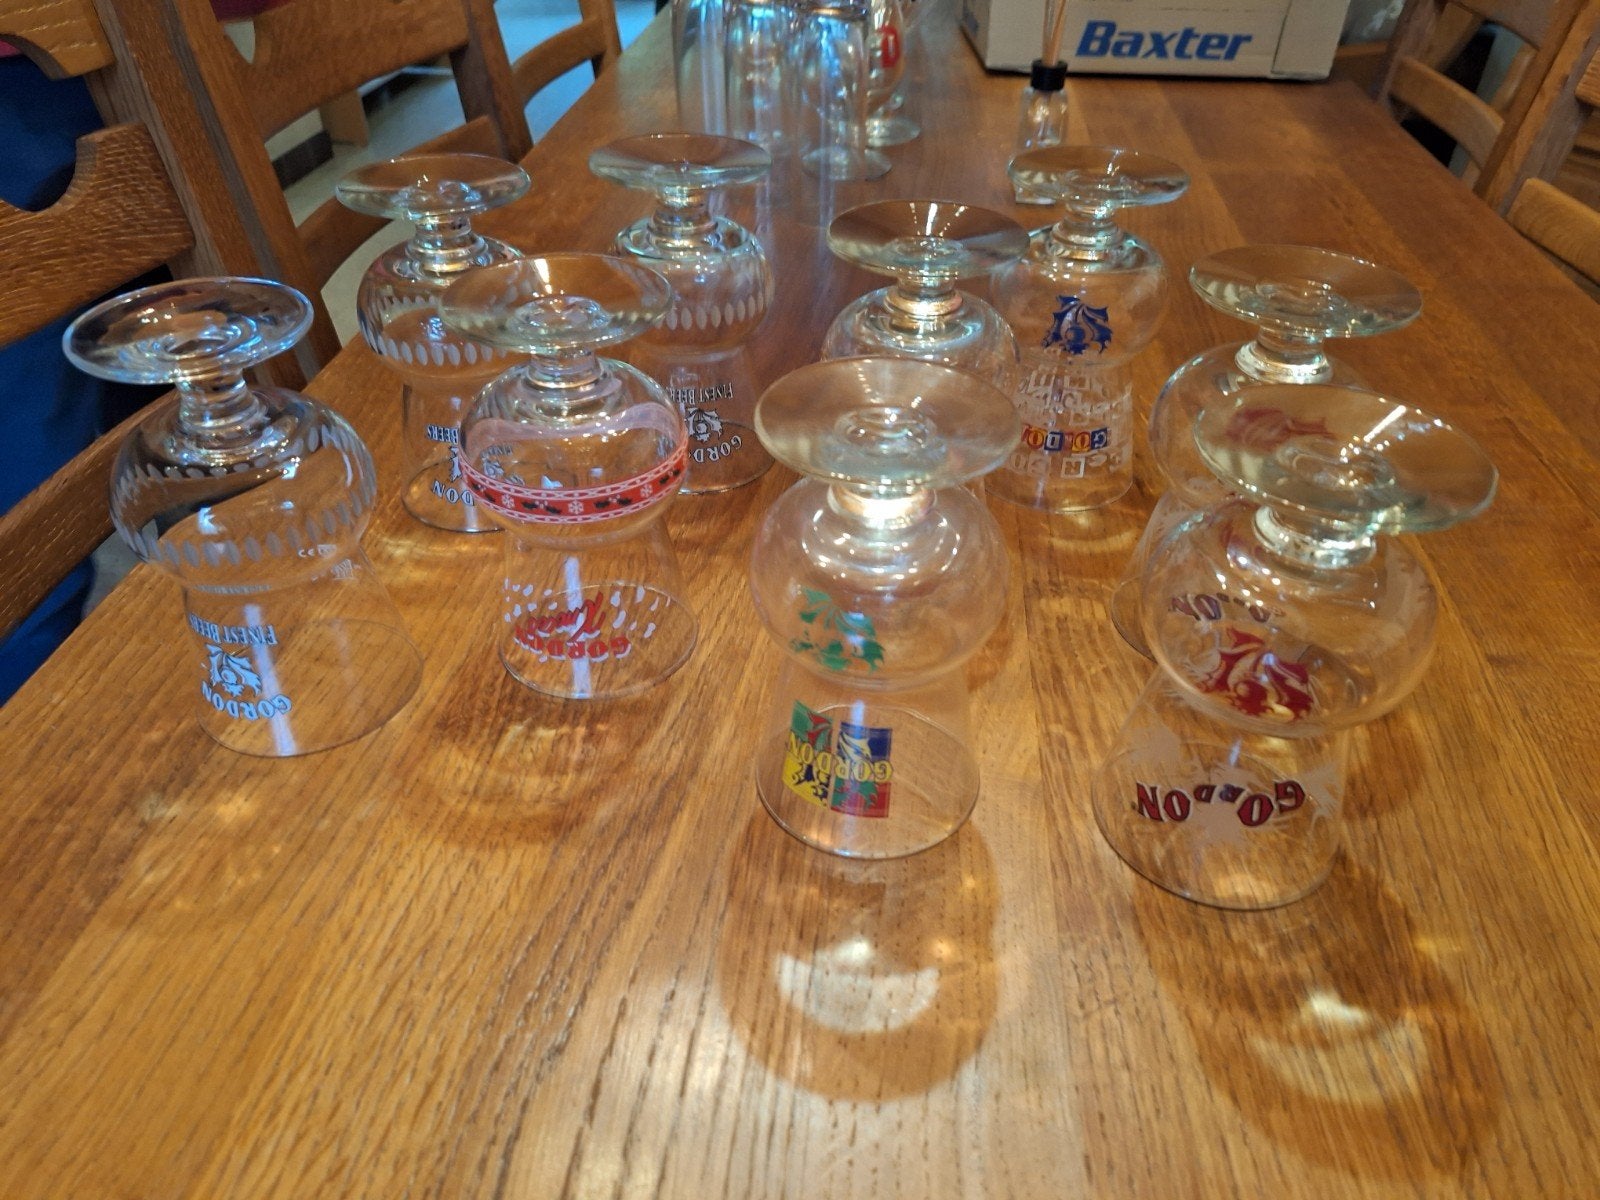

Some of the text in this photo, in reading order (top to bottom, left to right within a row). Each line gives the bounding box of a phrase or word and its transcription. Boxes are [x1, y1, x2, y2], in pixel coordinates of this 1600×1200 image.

[1075, 21, 1252, 60] Baxter
[667, 382, 733, 405] FINEST BEER
[425, 425, 458, 445] BEERS
[688, 435, 743, 463] GORD
[1021, 424, 1109, 454] GODO
[431, 480, 474, 506] DON
[223, 625, 277, 646] FINEST
[202, 682, 292, 720] GORDON
[786, 730, 893, 783] GORDON
[1133, 780, 1306, 827] GORDON
